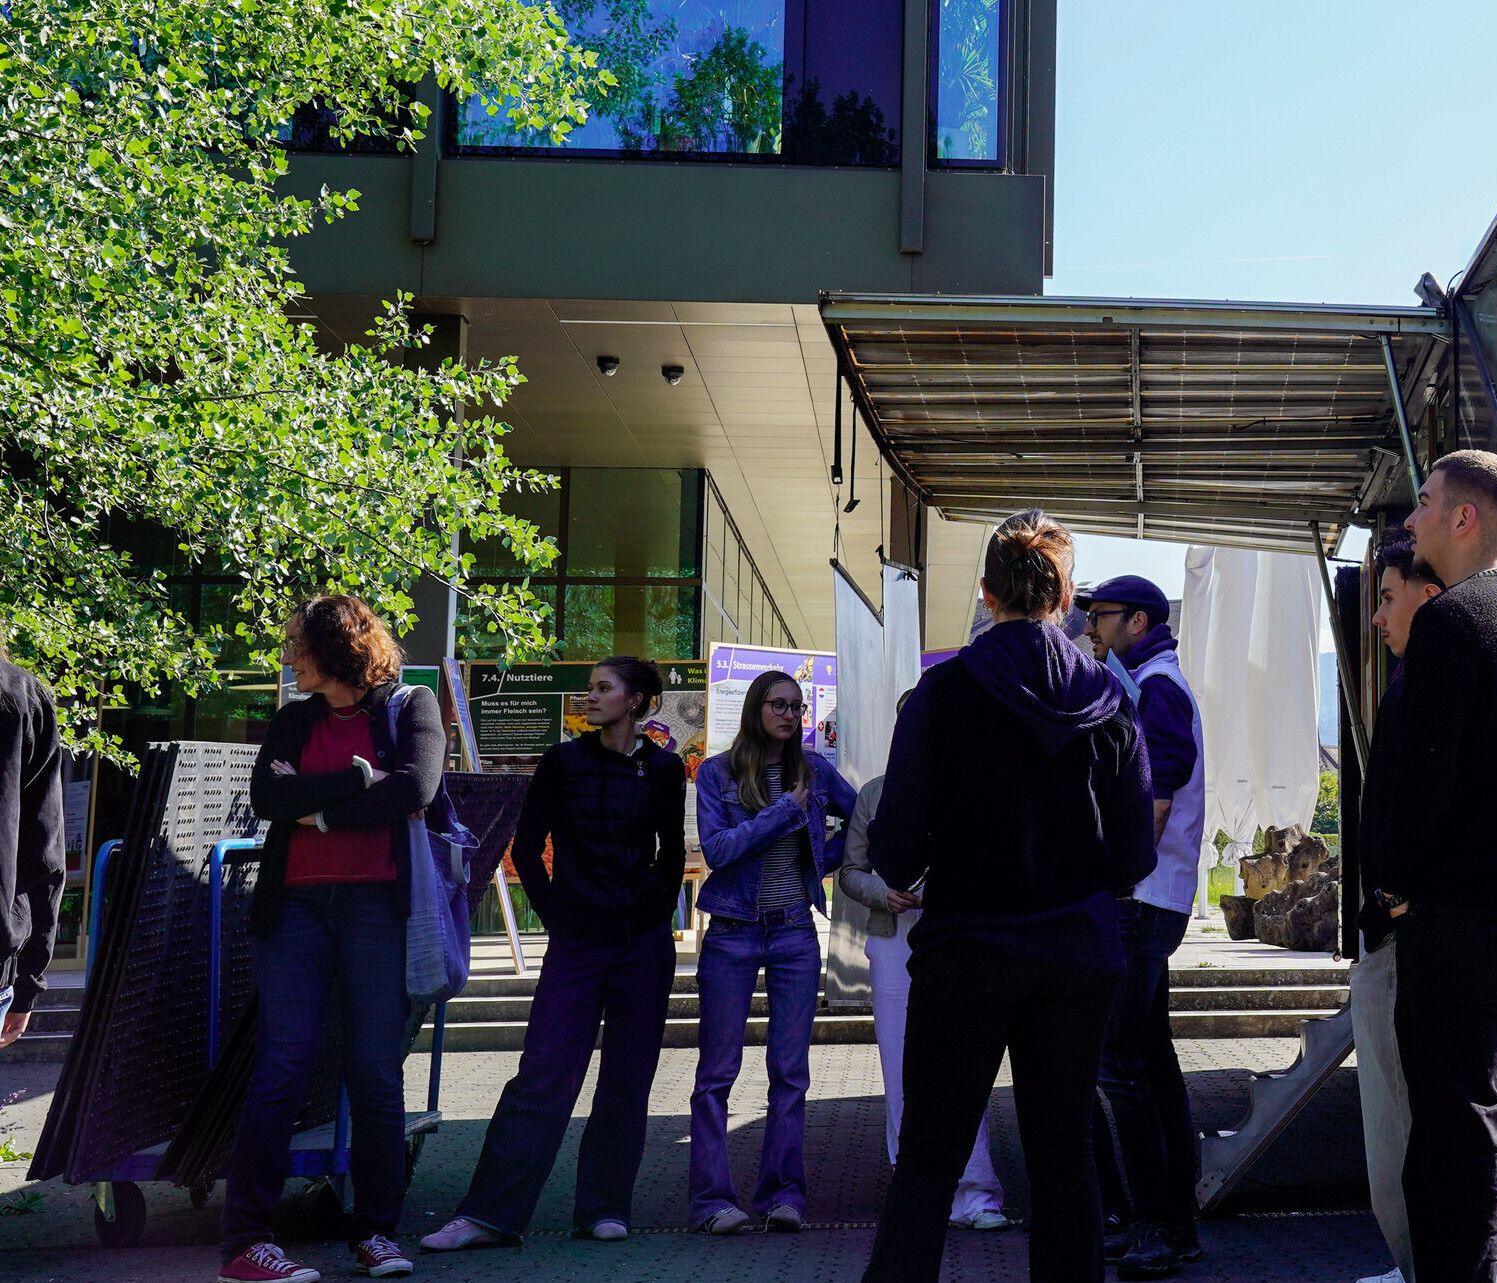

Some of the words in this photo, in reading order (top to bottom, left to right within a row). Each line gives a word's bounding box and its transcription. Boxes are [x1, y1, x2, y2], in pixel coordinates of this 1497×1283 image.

[716, 659, 729, 669] 5.3.
[732, 660, 784, 672] Strassenverkehr
[481, 674, 500, 682] 7.4.
[506, 673, 554, 682] Nutztiere
